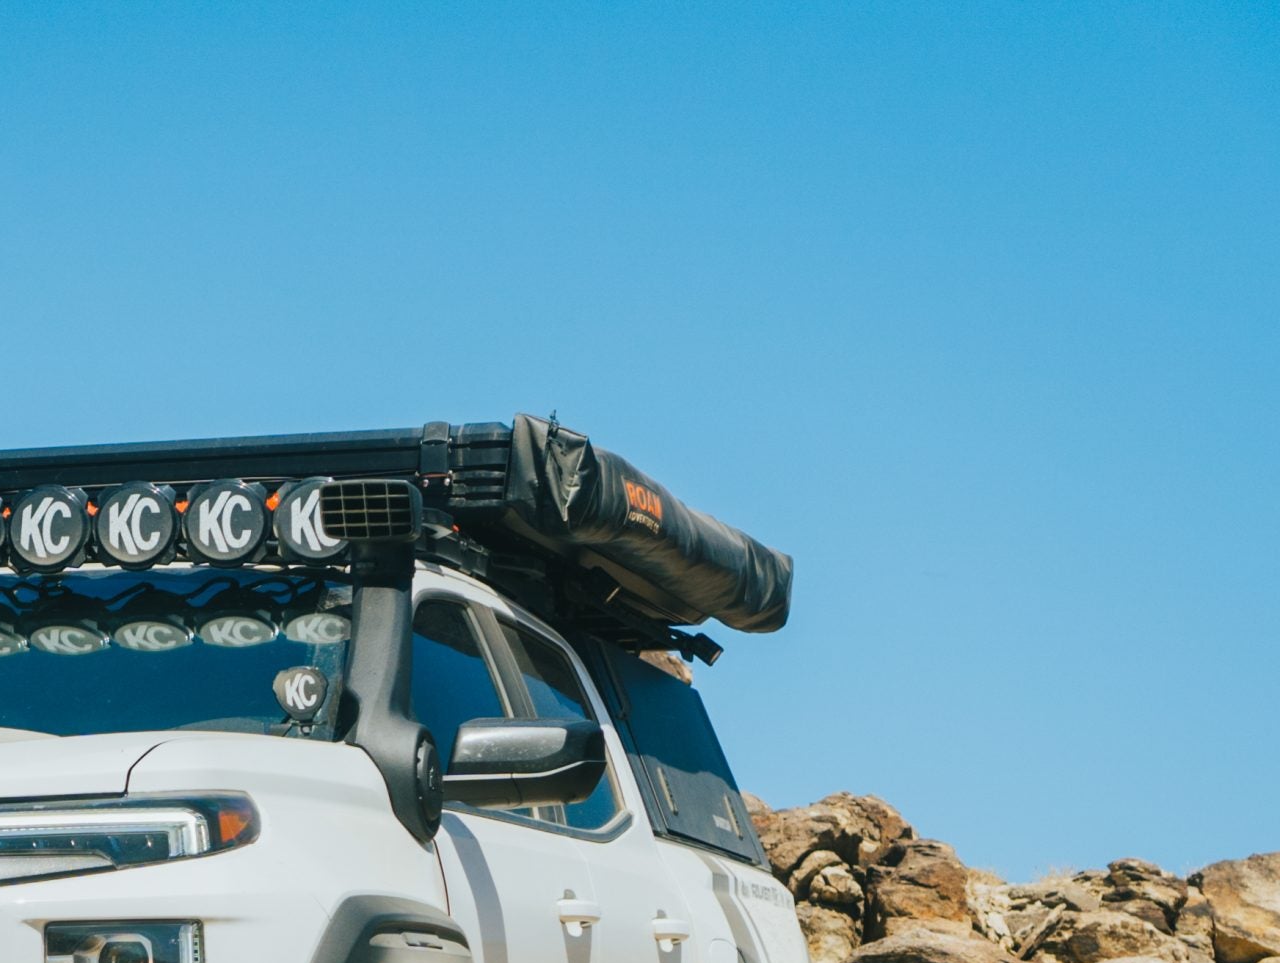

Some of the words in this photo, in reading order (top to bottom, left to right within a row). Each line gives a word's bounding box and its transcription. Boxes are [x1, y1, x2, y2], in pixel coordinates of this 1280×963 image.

[20, 497, 72, 558] KC
[109, 493, 161, 556] KC
[199, 490, 252, 553] KC
[284, 672, 317, 710] KC
